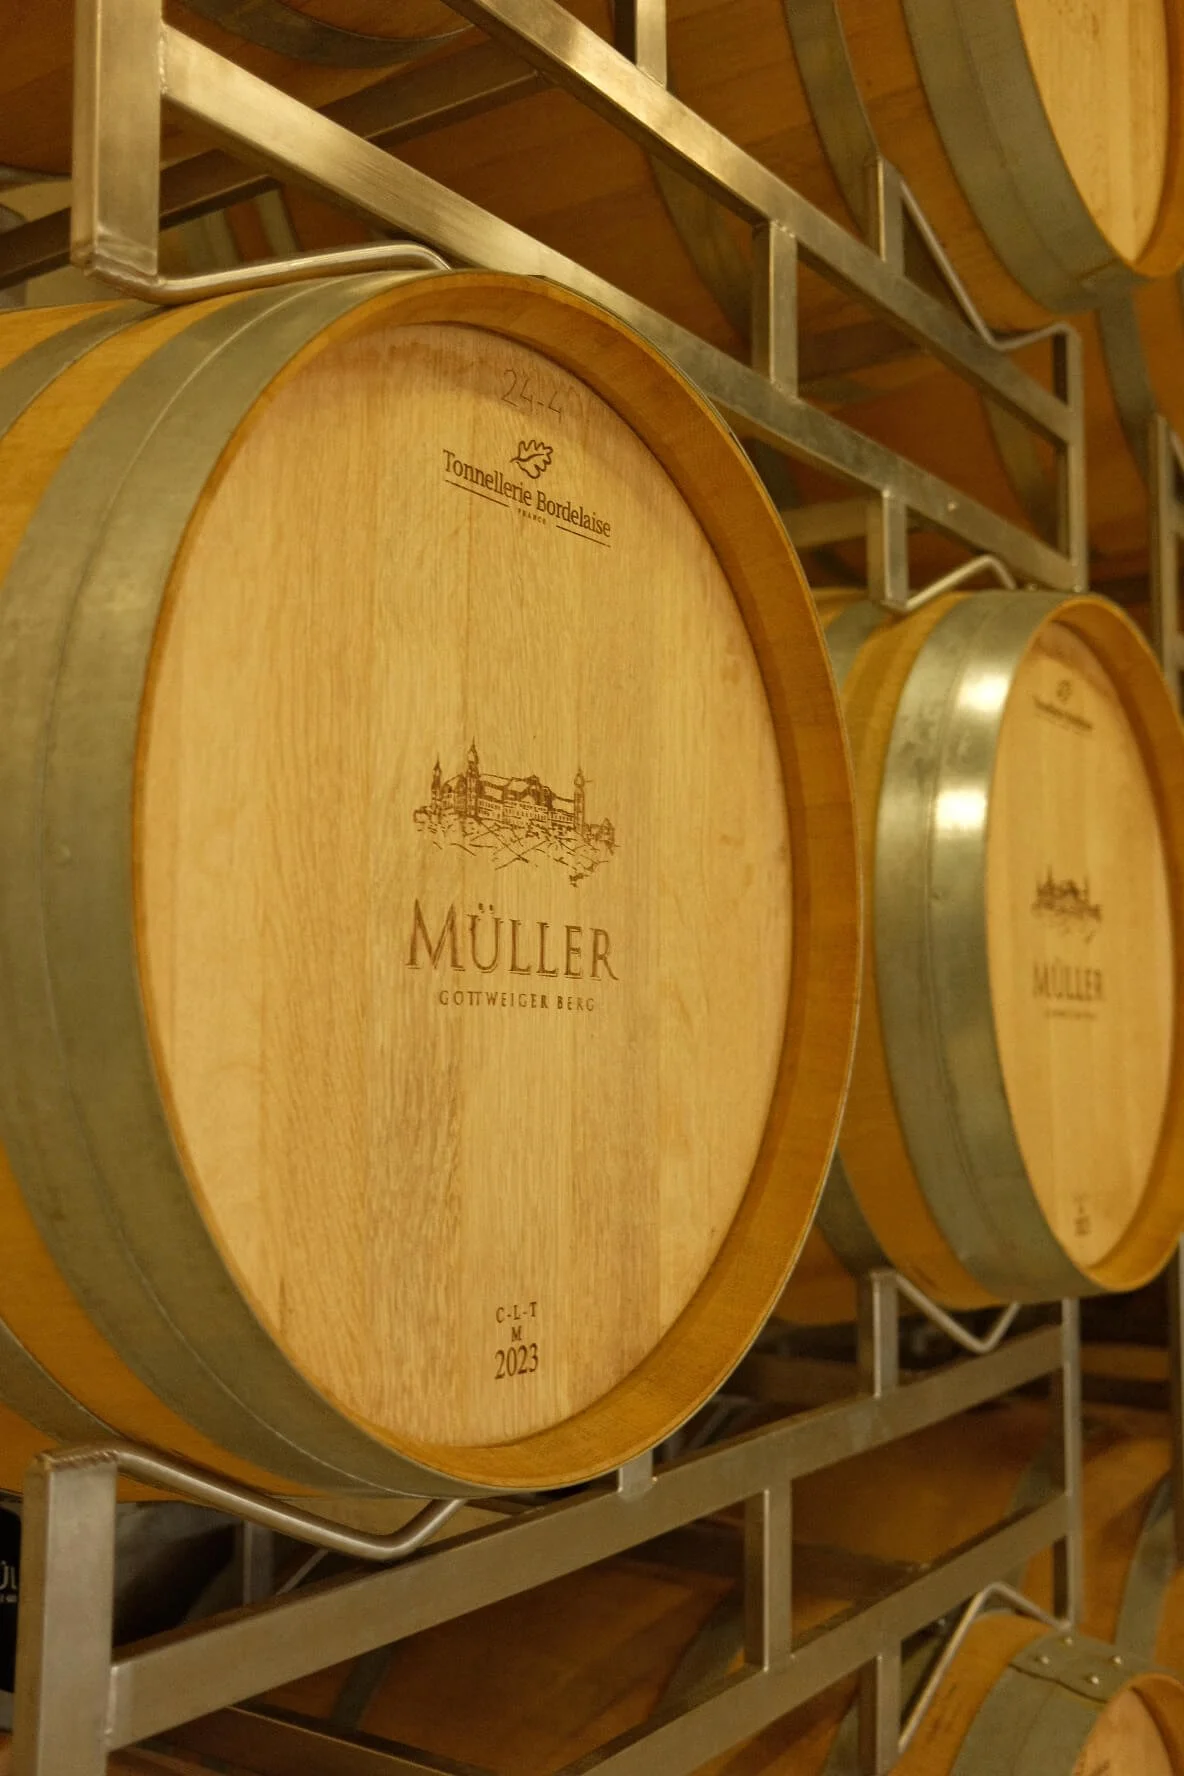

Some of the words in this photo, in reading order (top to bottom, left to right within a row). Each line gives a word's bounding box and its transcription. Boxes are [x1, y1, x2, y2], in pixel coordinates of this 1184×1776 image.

[443, 449, 533, 507] Tonnellerie
[536, 489, 612, 538] Bordelaise
[404, 897, 620, 982] MÜLLER
[438, 989, 549, 1010] GOTTWEIGER
[556, 995, 596, 1012] BERG
[511, 1324, 523, 1342] M
[494, 1342, 539, 1380] 2023
